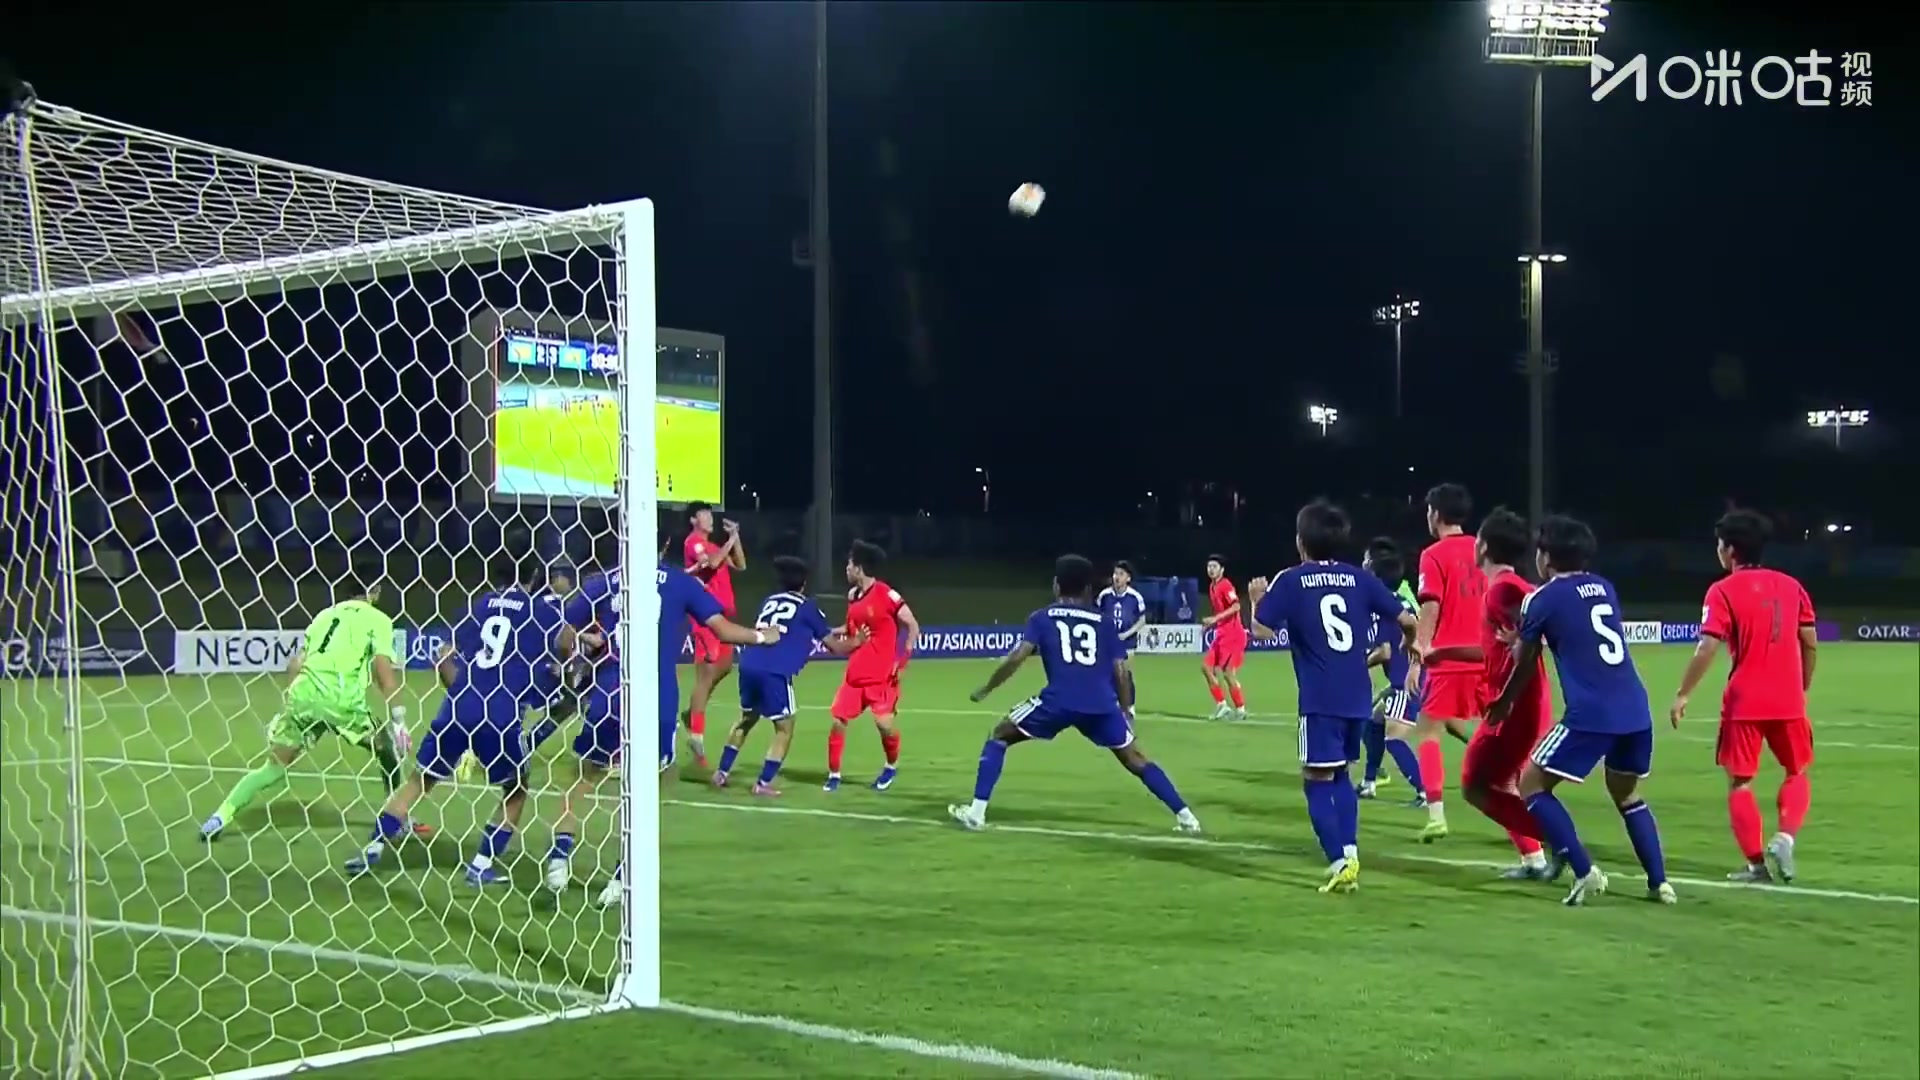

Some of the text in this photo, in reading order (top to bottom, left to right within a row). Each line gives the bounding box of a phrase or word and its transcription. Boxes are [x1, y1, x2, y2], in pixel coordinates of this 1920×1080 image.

[755, 600, 797, 633] 22
[1320, 593, 1353, 652] 6
[1591, 603, 1624, 665] 5
[1624, 624, 1657, 640] M.COM
[1857, 624, 1910, 639] QATAR
[317, 617, 340, 654] 1
[475, 615, 511, 669] 9
[942, 633, 984, 650] ASIAN
[986, 632, 1013, 650] CUP
[1056, 620, 1097, 666] 13
